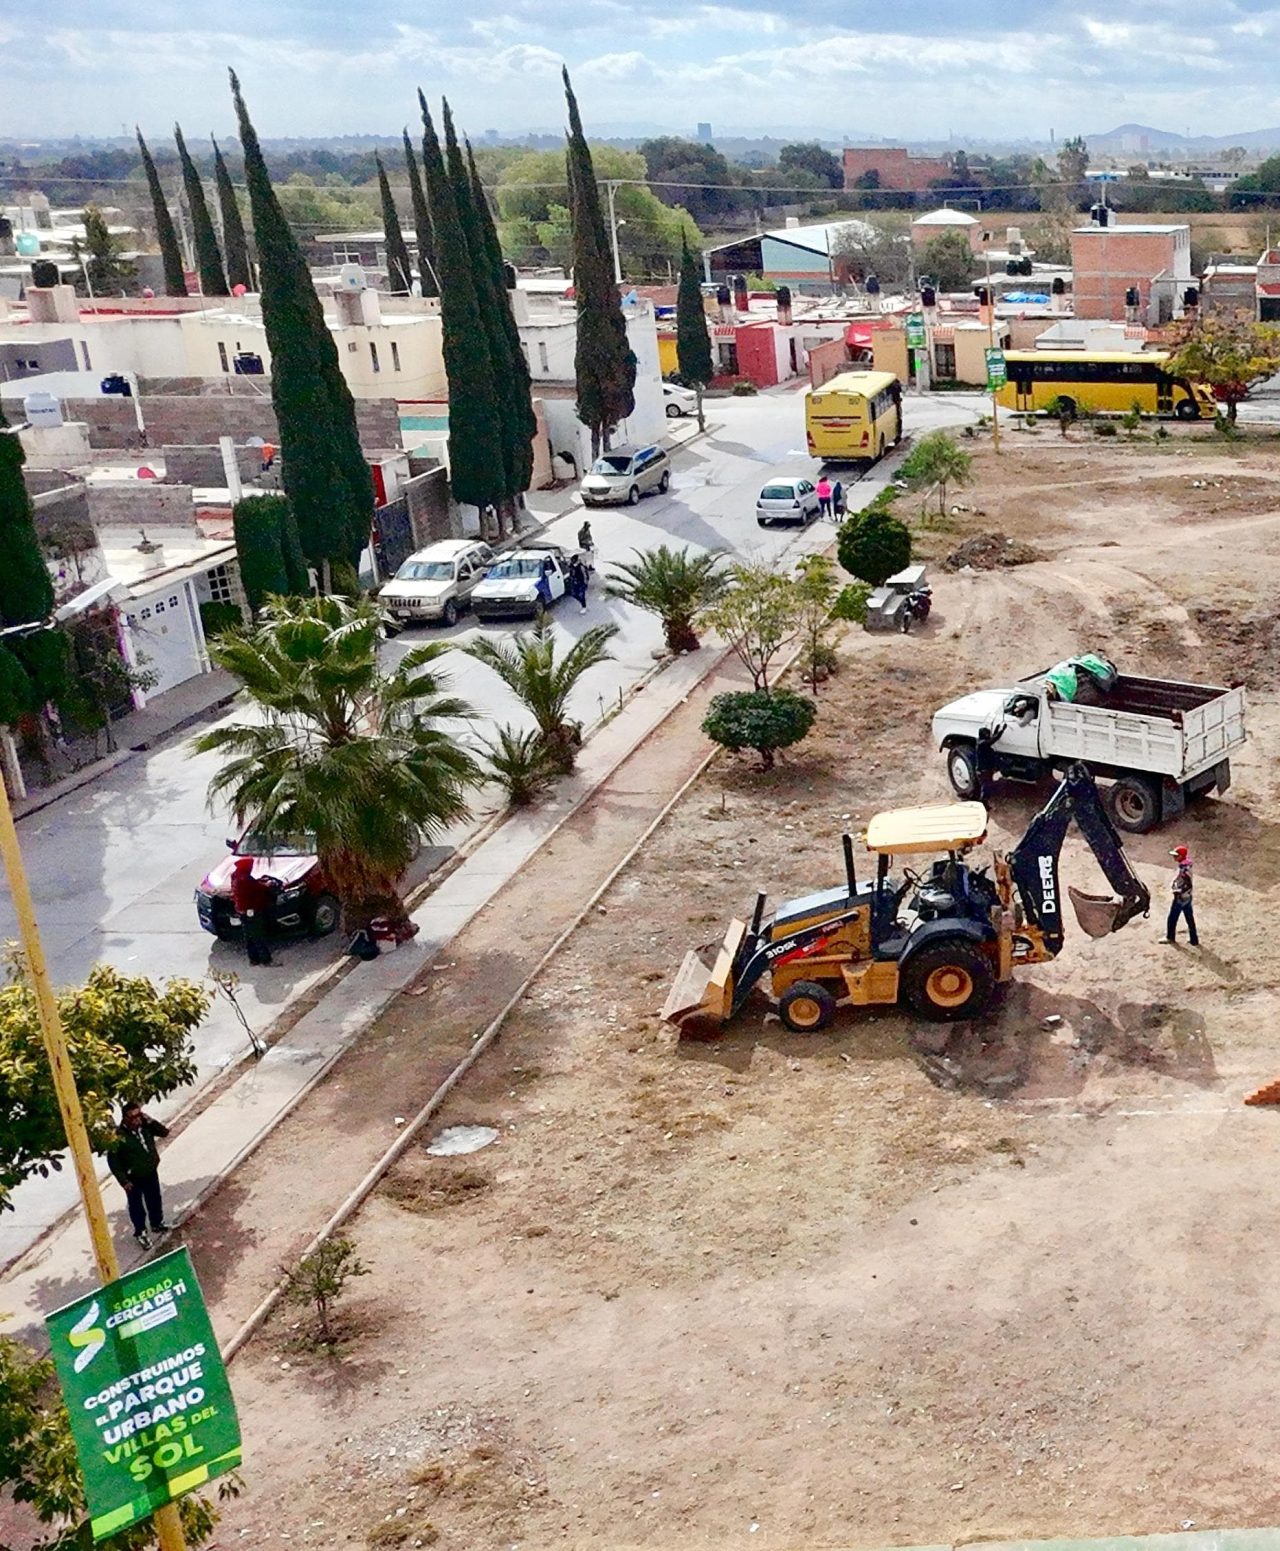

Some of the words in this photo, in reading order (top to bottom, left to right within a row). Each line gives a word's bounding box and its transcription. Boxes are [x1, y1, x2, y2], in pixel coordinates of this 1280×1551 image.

[1038, 855, 1056, 913] DEERE
[105, 1300, 154, 1329] CERCA
[153, 1289, 174, 1307] DE
[113, 1278, 173, 1313] SOLEDAD
[83, 1342, 206, 1410] CONSTRUIMOS
[95, 1413, 111, 1427] EL
[108, 1361, 204, 1422] PARQUE
[102, 1386, 205, 1445] URBANO
[102, 1414, 188, 1466] VILLAS
[190, 1404, 218, 1427] DEL
[129, 1433, 204, 1482] SOL
